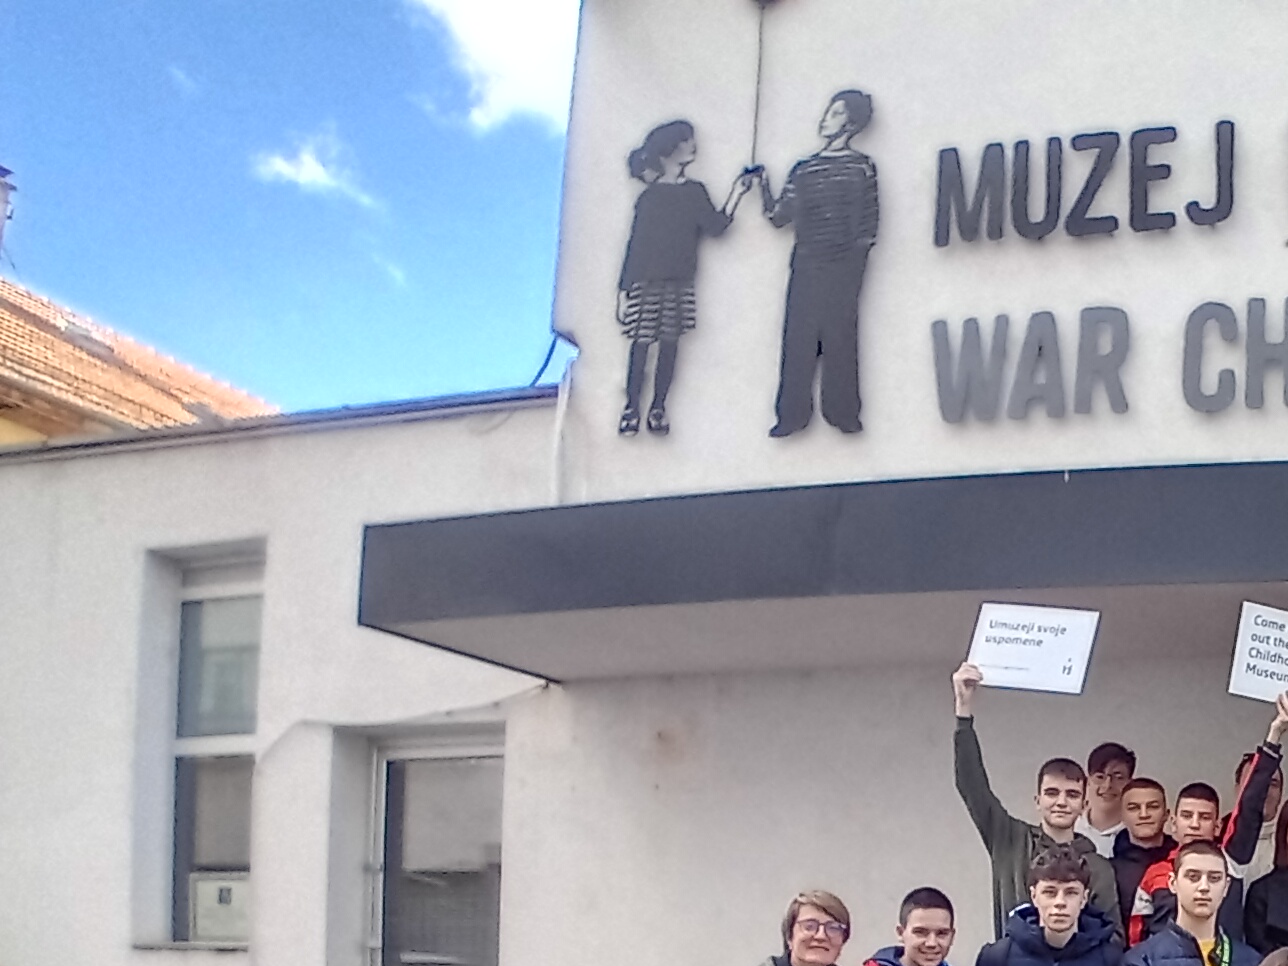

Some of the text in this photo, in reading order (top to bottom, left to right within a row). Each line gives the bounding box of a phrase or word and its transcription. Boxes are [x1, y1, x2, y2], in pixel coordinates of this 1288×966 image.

[933, 120, 1235, 247] MUZEJ
[931, 306, 1130, 424] WAR
[1037, 624, 1067, 637] svoje
[1254, 615, 1286, 632] Come
[985, 635, 1043, 647] uspomene
[1251, 633, 1271, 646] out
